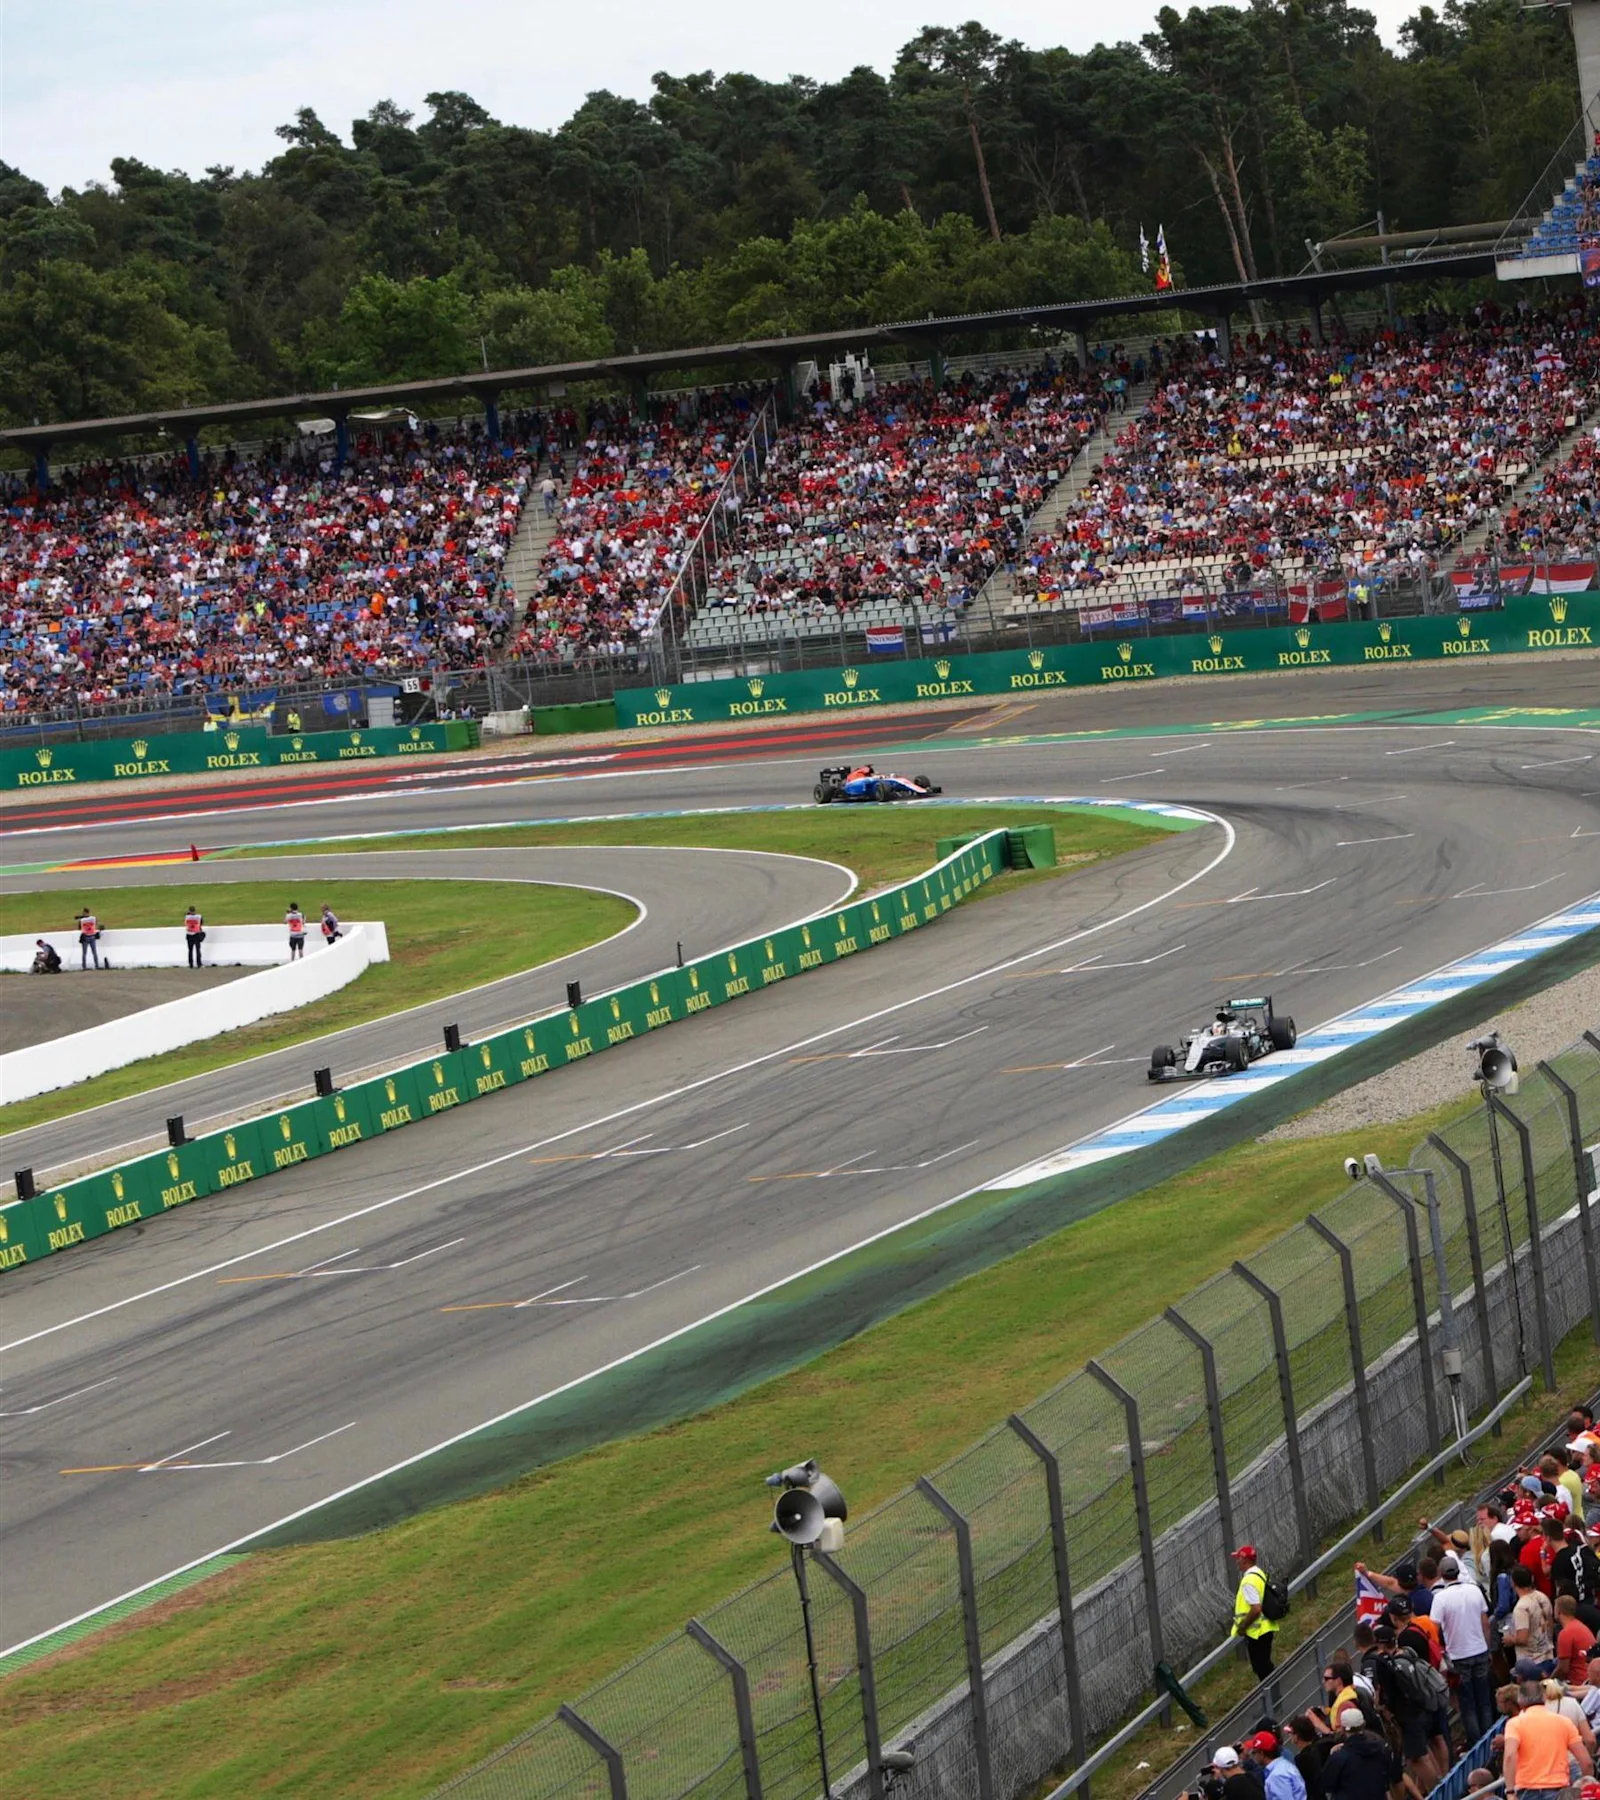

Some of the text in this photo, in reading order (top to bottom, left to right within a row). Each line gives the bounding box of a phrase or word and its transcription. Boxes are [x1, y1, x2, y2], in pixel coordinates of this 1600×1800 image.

[1528, 627, 1592, 647] ROLEX
[1365, 645, 1411, 659] ROLEX
[1443, 639, 1490, 654] ROLEX
[1192, 657, 1244, 672] ROLEX
[1279, 650, 1330, 665] ROLEX
[1011, 671, 1066, 687] ROLEX
[1102, 664, 1154, 678] ROLEX
[824, 689, 880, 705] ROLEX
[917, 681, 973, 696] ROLEX
[730, 699, 786, 715] ROLEX
[636, 709, 693, 725] ROLEX
[340, 747, 375, 757] ROLEX
[399, 742, 434, 752] ROLEX
[208, 753, 260, 767] ROLEX
[281, 752, 317, 762] ROLEX
[19, 769, 75, 785] ROLEX
[114, 760, 170, 776] ROLEX
[835, 937, 857, 955] ROLEX
[800, 950, 822, 967] ROLEX
[763, 963, 785, 982] ROLEX
[726, 977, 748, 996] ROLEX
[687, 992, 711, 1011] ROLEX
[647, 1007, 671, 1027] ROLEX
[608, 1022, 633, 1042] ROLEX
[566, 1038, 592, 1058] ROLEX
[521, 1055, 548, 1076] ROLEX
[477, 1071, 504, 1092] ROLEX
[429, 1088, 459, 1110] ROLEX
[381, 1106, 411, 1128] ROLEX
[329, 1123, 361, 1146] ROLEX
[274, 1142, 307, 1167] ROLEX
[219, 1162, 253, 1185] ROLEX
[162, 1182, 196, 1207] ROLEX
[107, 1202, 141, 1227] ROLEX
[49, 1223, 84, 1248] ROLEX
[0, 1244, 26, 1268] OLEX
